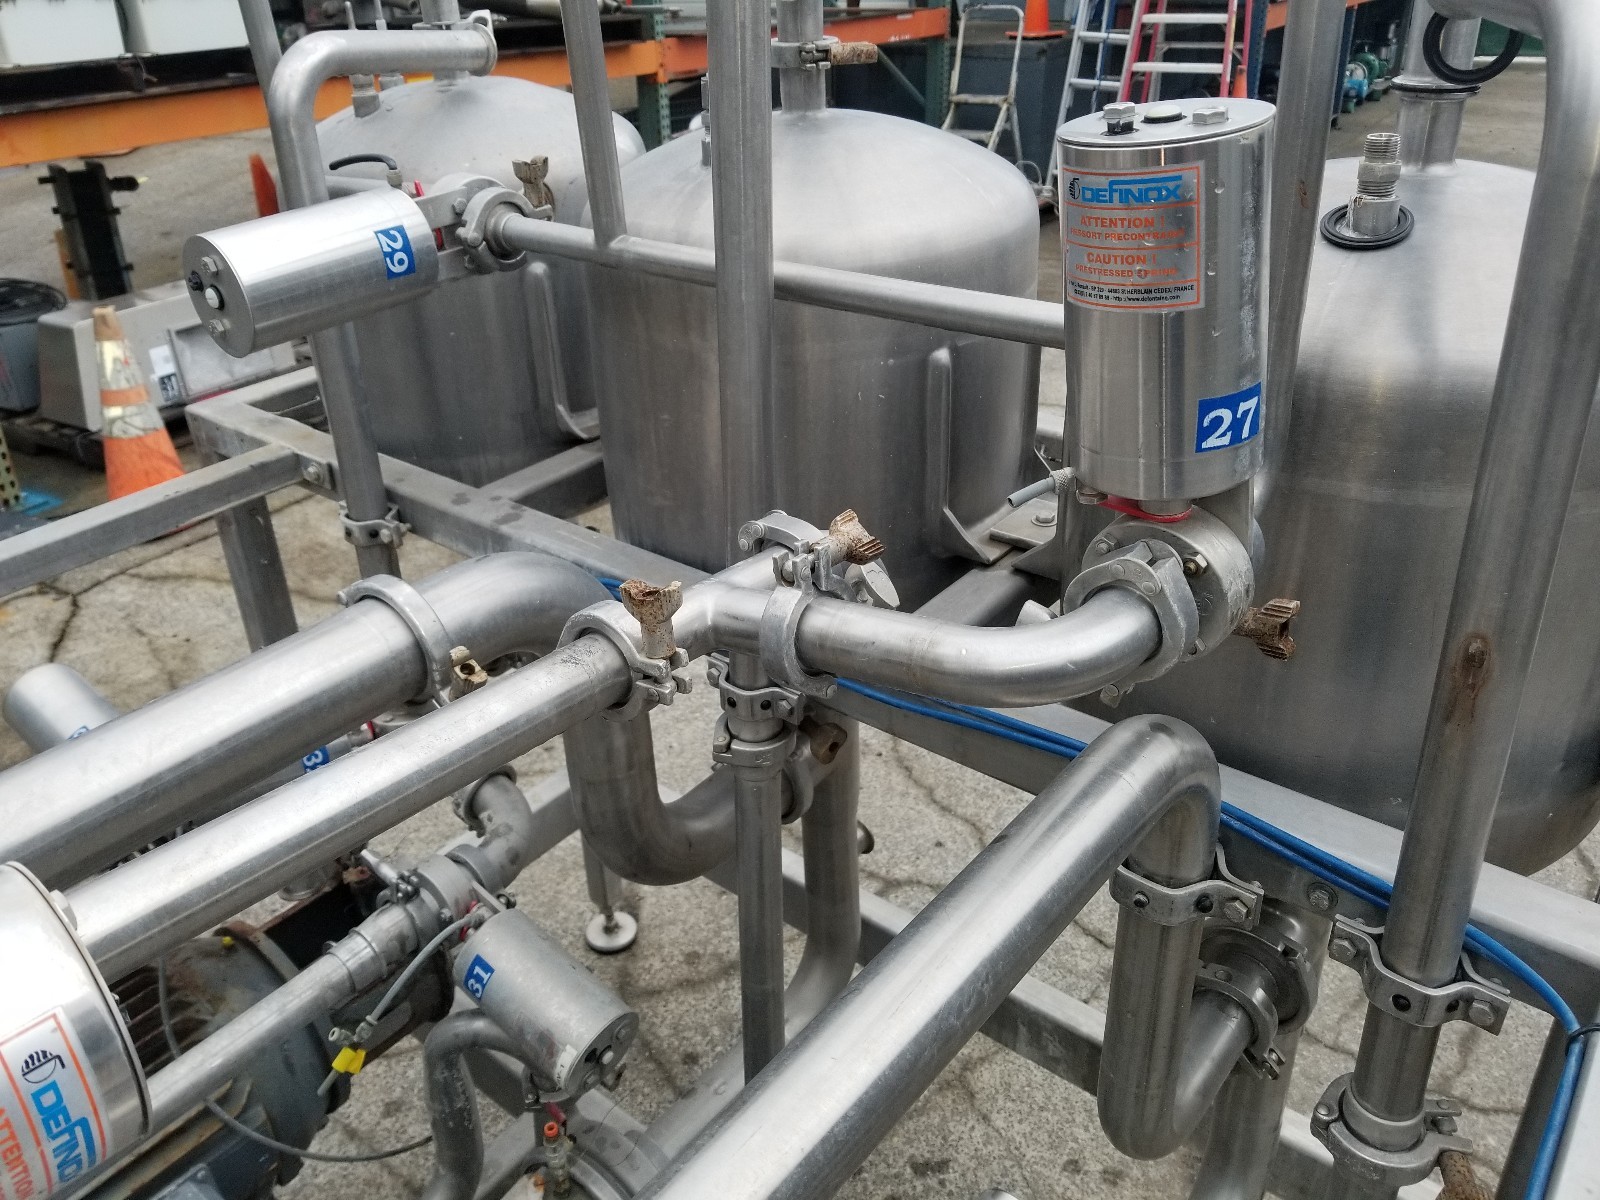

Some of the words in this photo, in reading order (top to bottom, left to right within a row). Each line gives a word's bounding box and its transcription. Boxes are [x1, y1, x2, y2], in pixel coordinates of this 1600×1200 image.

[1081, 175, 1182, 204] DEFINOX
[1080, 215, 1155, 229] ATTENTION
[377, 230, 409, 273] 29
[1086, 252, 1147, 266] CAUTION
[1075, 263, 1134, 278] PRESTRESSED
[1173, 285, 1194, 293] FRANCE
[1201, 396, 1258, 449] 27
[468, 965, 491, 998] 31
